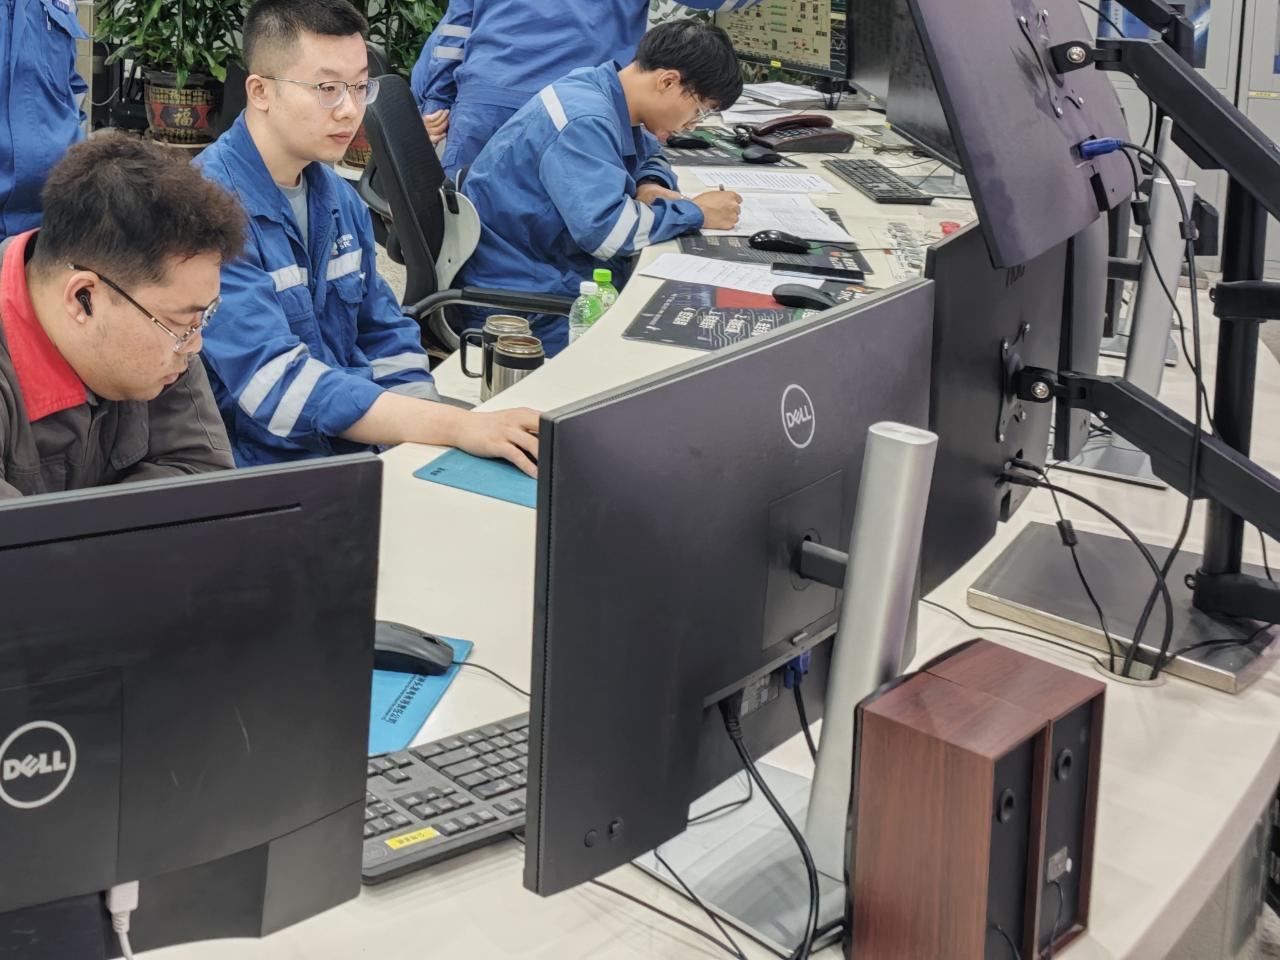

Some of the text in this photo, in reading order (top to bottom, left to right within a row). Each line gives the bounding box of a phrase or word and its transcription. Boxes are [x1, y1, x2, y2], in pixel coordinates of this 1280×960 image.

[174, 107, 194, 127] 福
[785, 405, 812, 428] DELL
[3, 750, 67, 781] DELL
